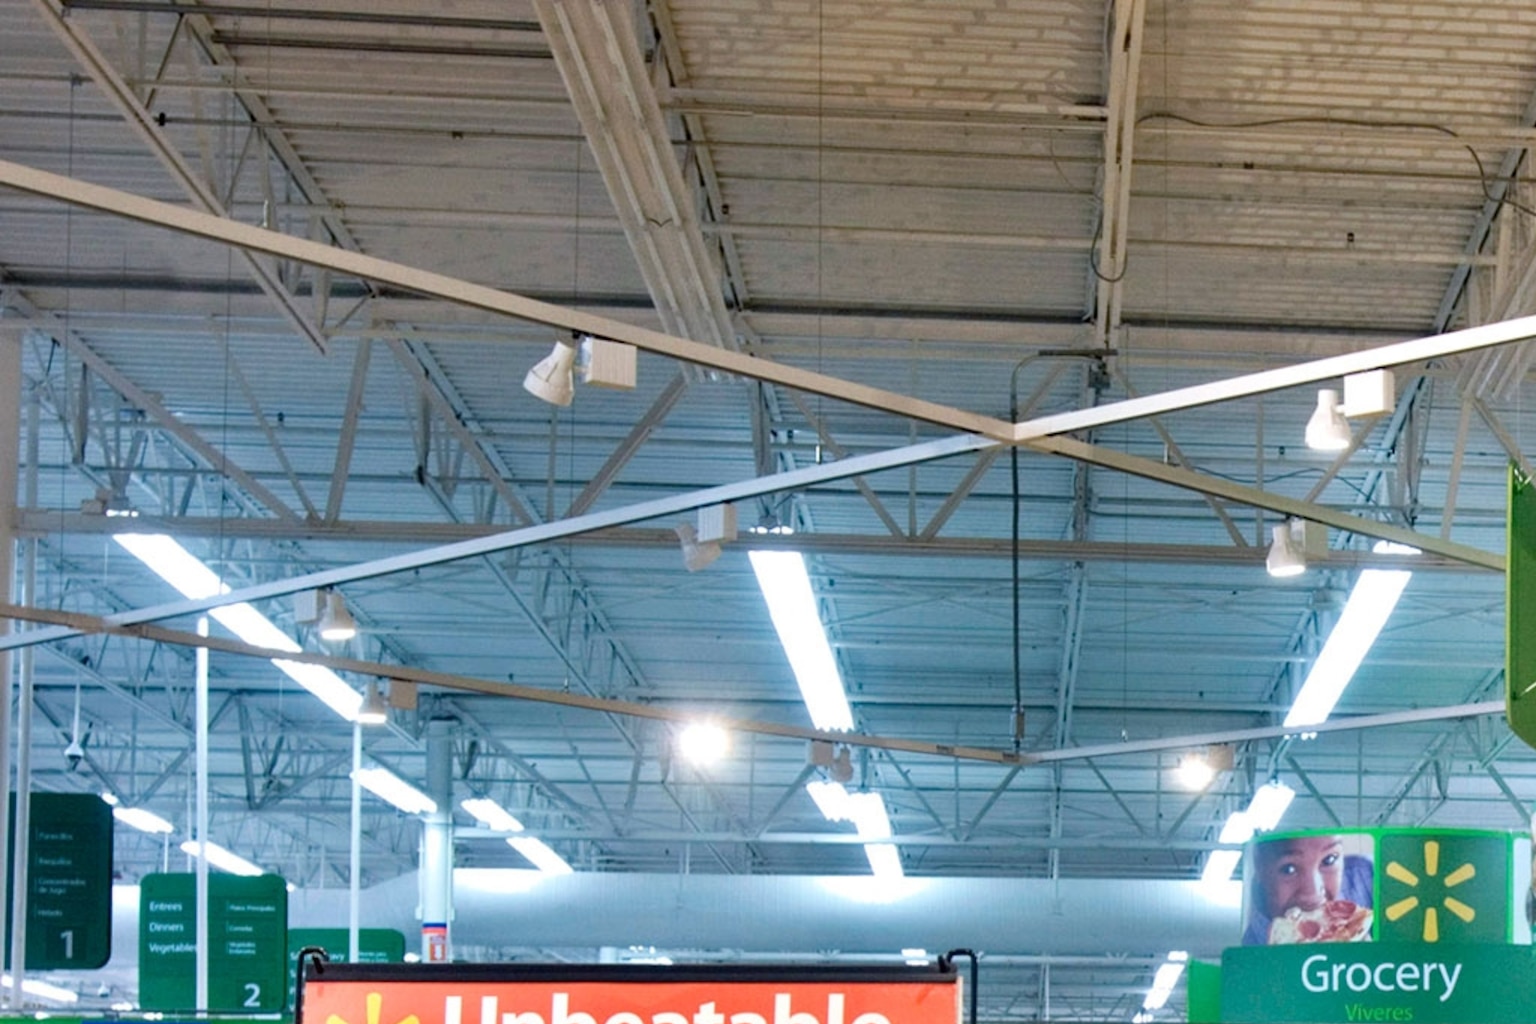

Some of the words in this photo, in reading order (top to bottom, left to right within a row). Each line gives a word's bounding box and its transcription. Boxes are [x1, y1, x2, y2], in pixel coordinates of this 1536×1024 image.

[150, 902, 182, 911] Entrees
[150, 923, 184, 932] Dinners
[60, 930, 73, 959] 1
[1302, 955, 1462, 1001] Grocery
[244, 983, 261, 1008] 2
